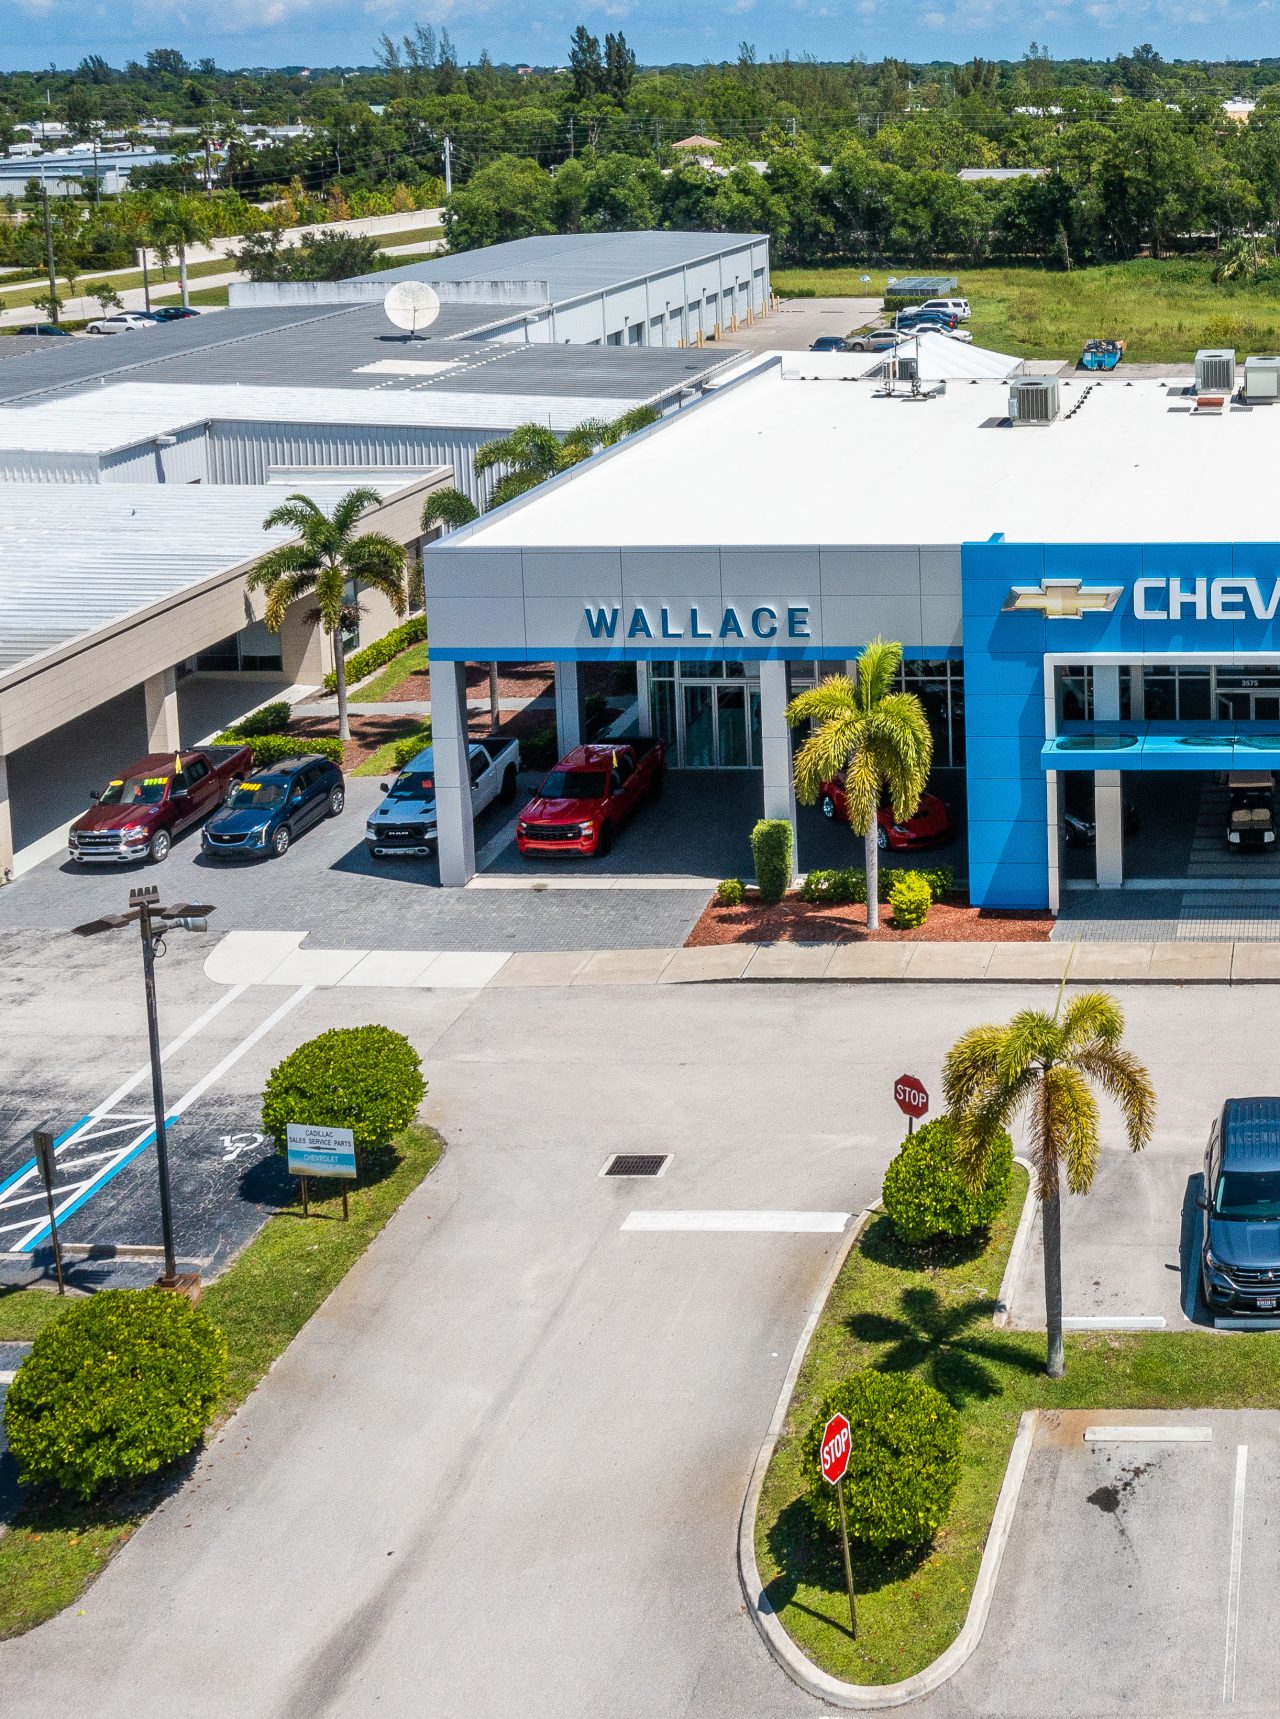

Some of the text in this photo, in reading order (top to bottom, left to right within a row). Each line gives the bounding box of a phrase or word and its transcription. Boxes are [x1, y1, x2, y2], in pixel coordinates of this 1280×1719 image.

[584, 606, 812, 639] WALLACE
[1241, 679, 1259, 687] 3575
[896, 1084, 927, 1107] STOP
[305, 1129, 333, 1138] CADILLAC
[289, 1136, 352, 1148] SALES SERVICE PARTS
[303, 1154, 339, 1163] CHEVROLET
[823, 1427, 849, 1470] STOP
